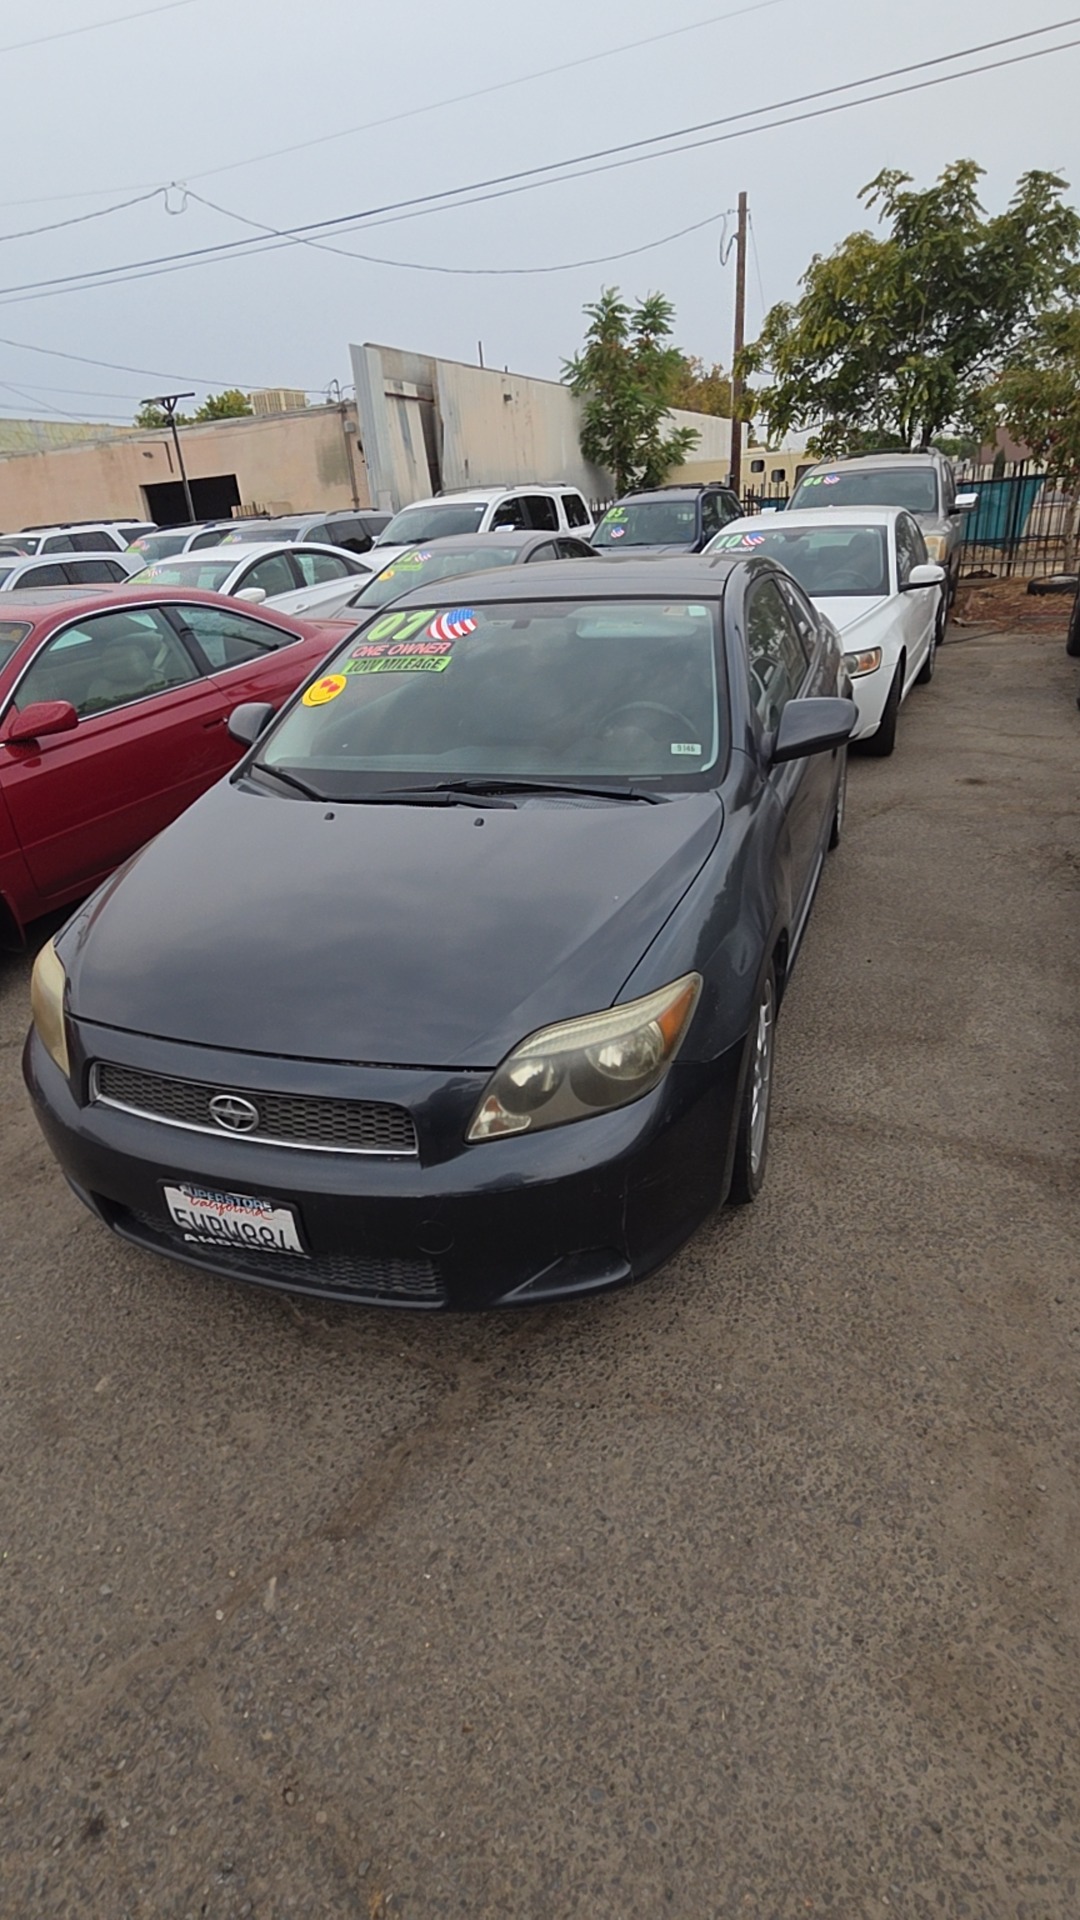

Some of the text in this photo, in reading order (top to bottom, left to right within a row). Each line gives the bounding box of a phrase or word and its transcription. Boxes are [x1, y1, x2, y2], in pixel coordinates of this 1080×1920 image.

[716, 534, 743, 549] 10
[367, 610, 437, 641] 07
[353, 642, 451, 658] ONE OWNER
[349, 657, 442, 672] LOW MILEAGE
[179, 1186, 273, 1211] SUPERSTORE
[186, 1194, 274, 1220] California
